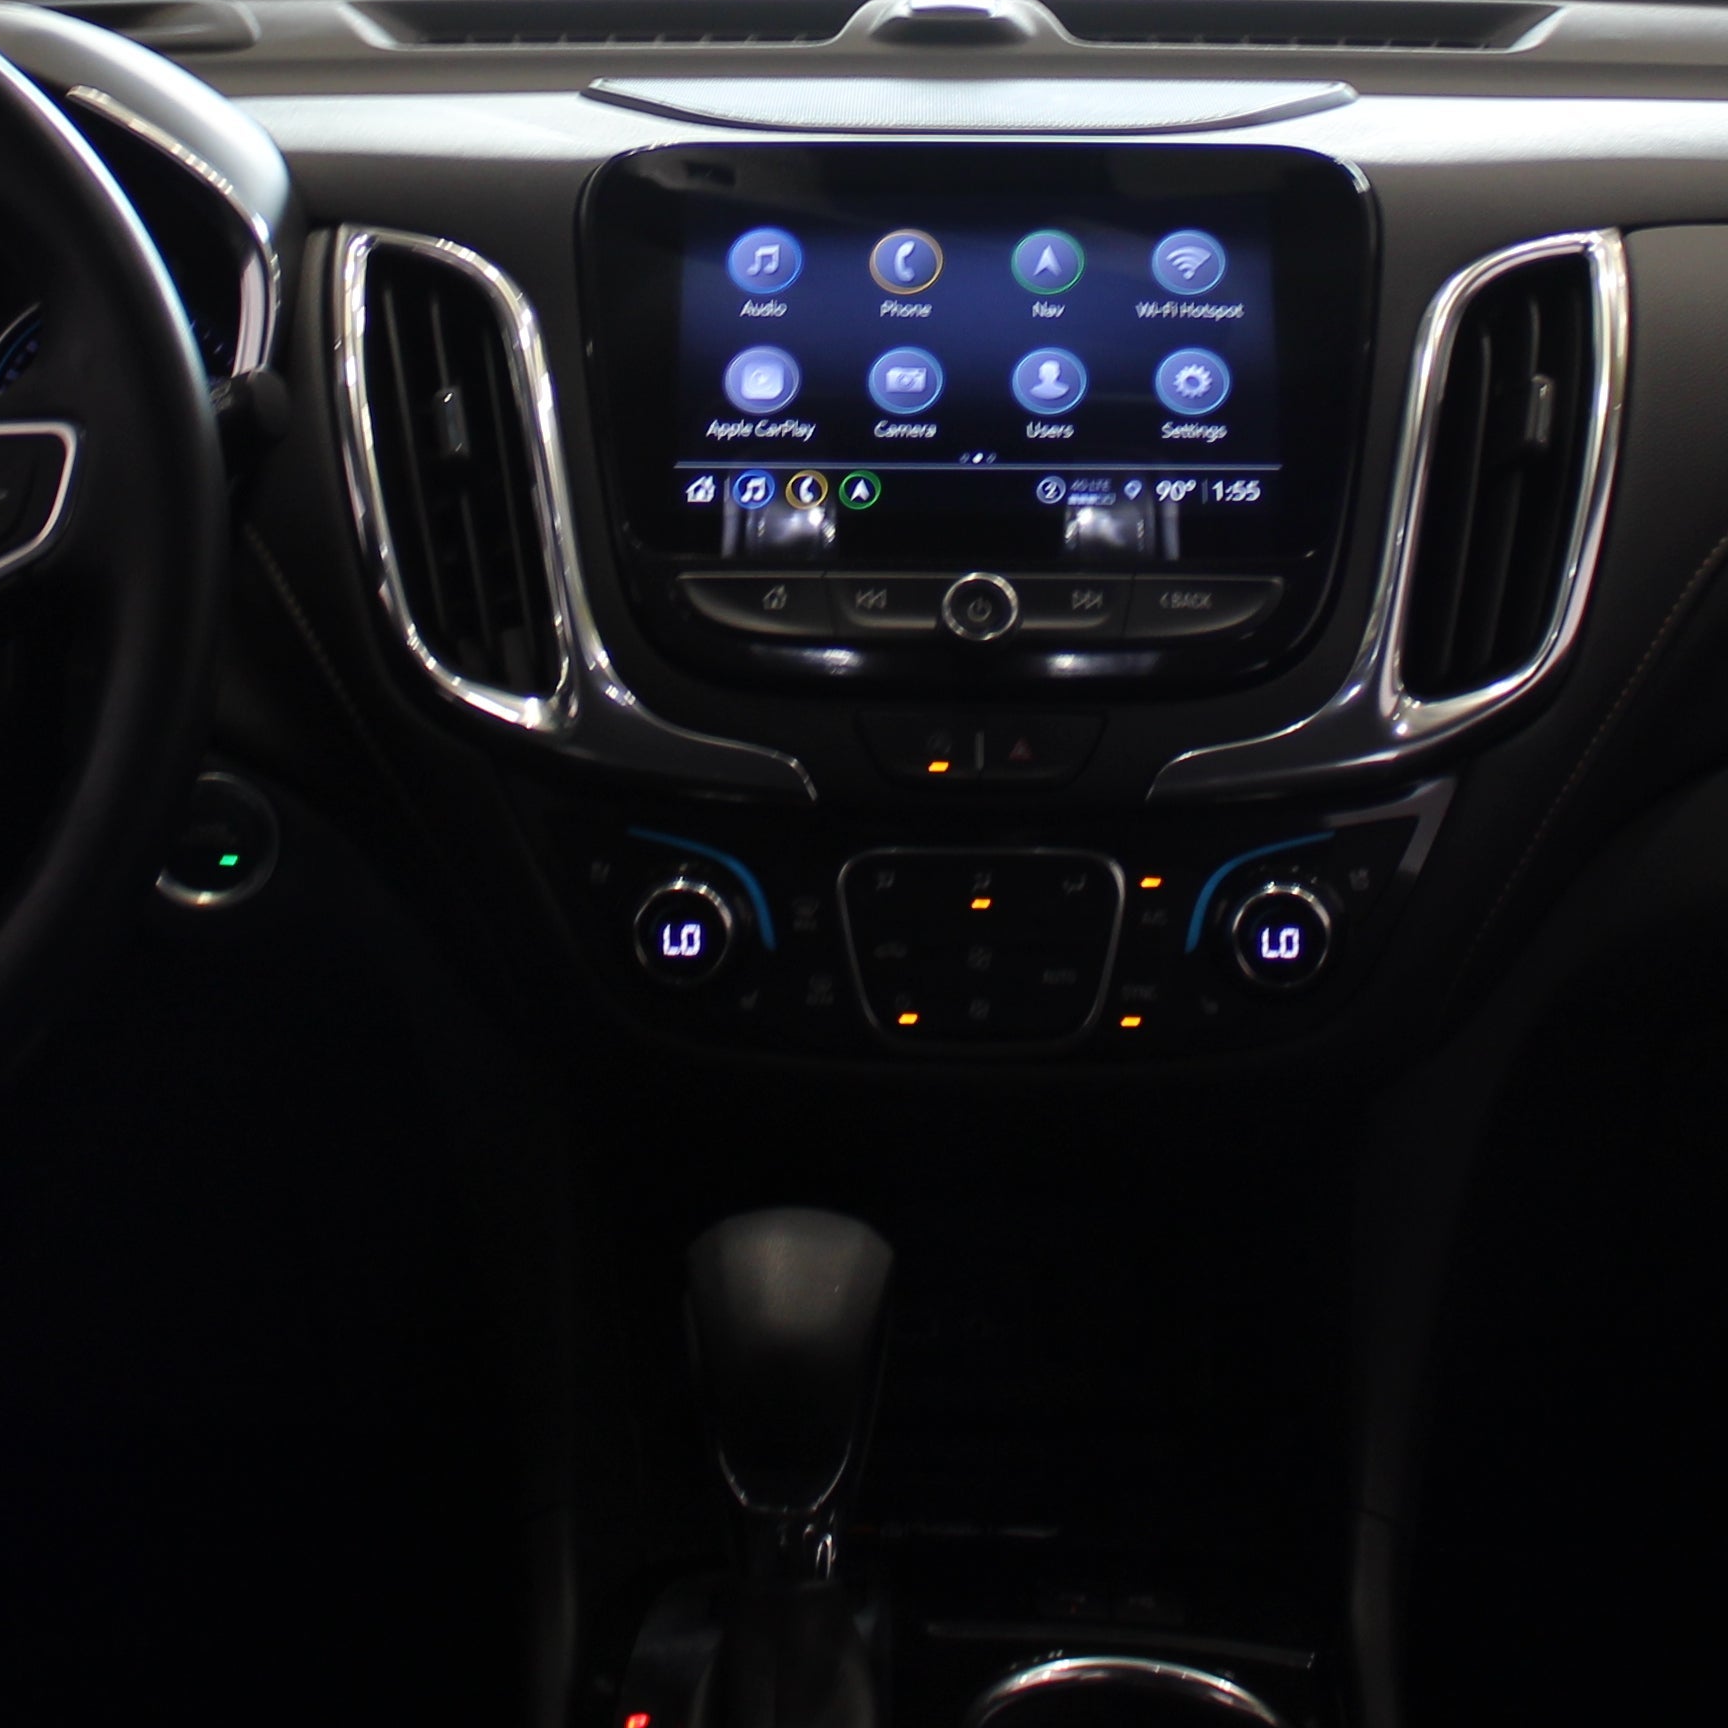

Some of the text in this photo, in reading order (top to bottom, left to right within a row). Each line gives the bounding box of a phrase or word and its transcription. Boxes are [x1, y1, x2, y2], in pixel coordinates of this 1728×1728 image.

[739, 299, 788, 317] Audio
[880, 300, 933, 317] Phone
[1032, 301, 1065, 318] Nav
[1135, 301, 1245, 321] Wi-Fi Hotspot
[705, 419, 817, 442] Apple CarPlay
[873, 420, 937, 438] Camera
[1026, 421, 1074, 439] Users
[1161, 421, 1227, 442] Settings
[1212, 480, 1261, 501] 1:55
[1171, 591, 1213, 609] BACK
[662, 923, 702, 957] LO
[1260, 927, 1300, 959] LO
